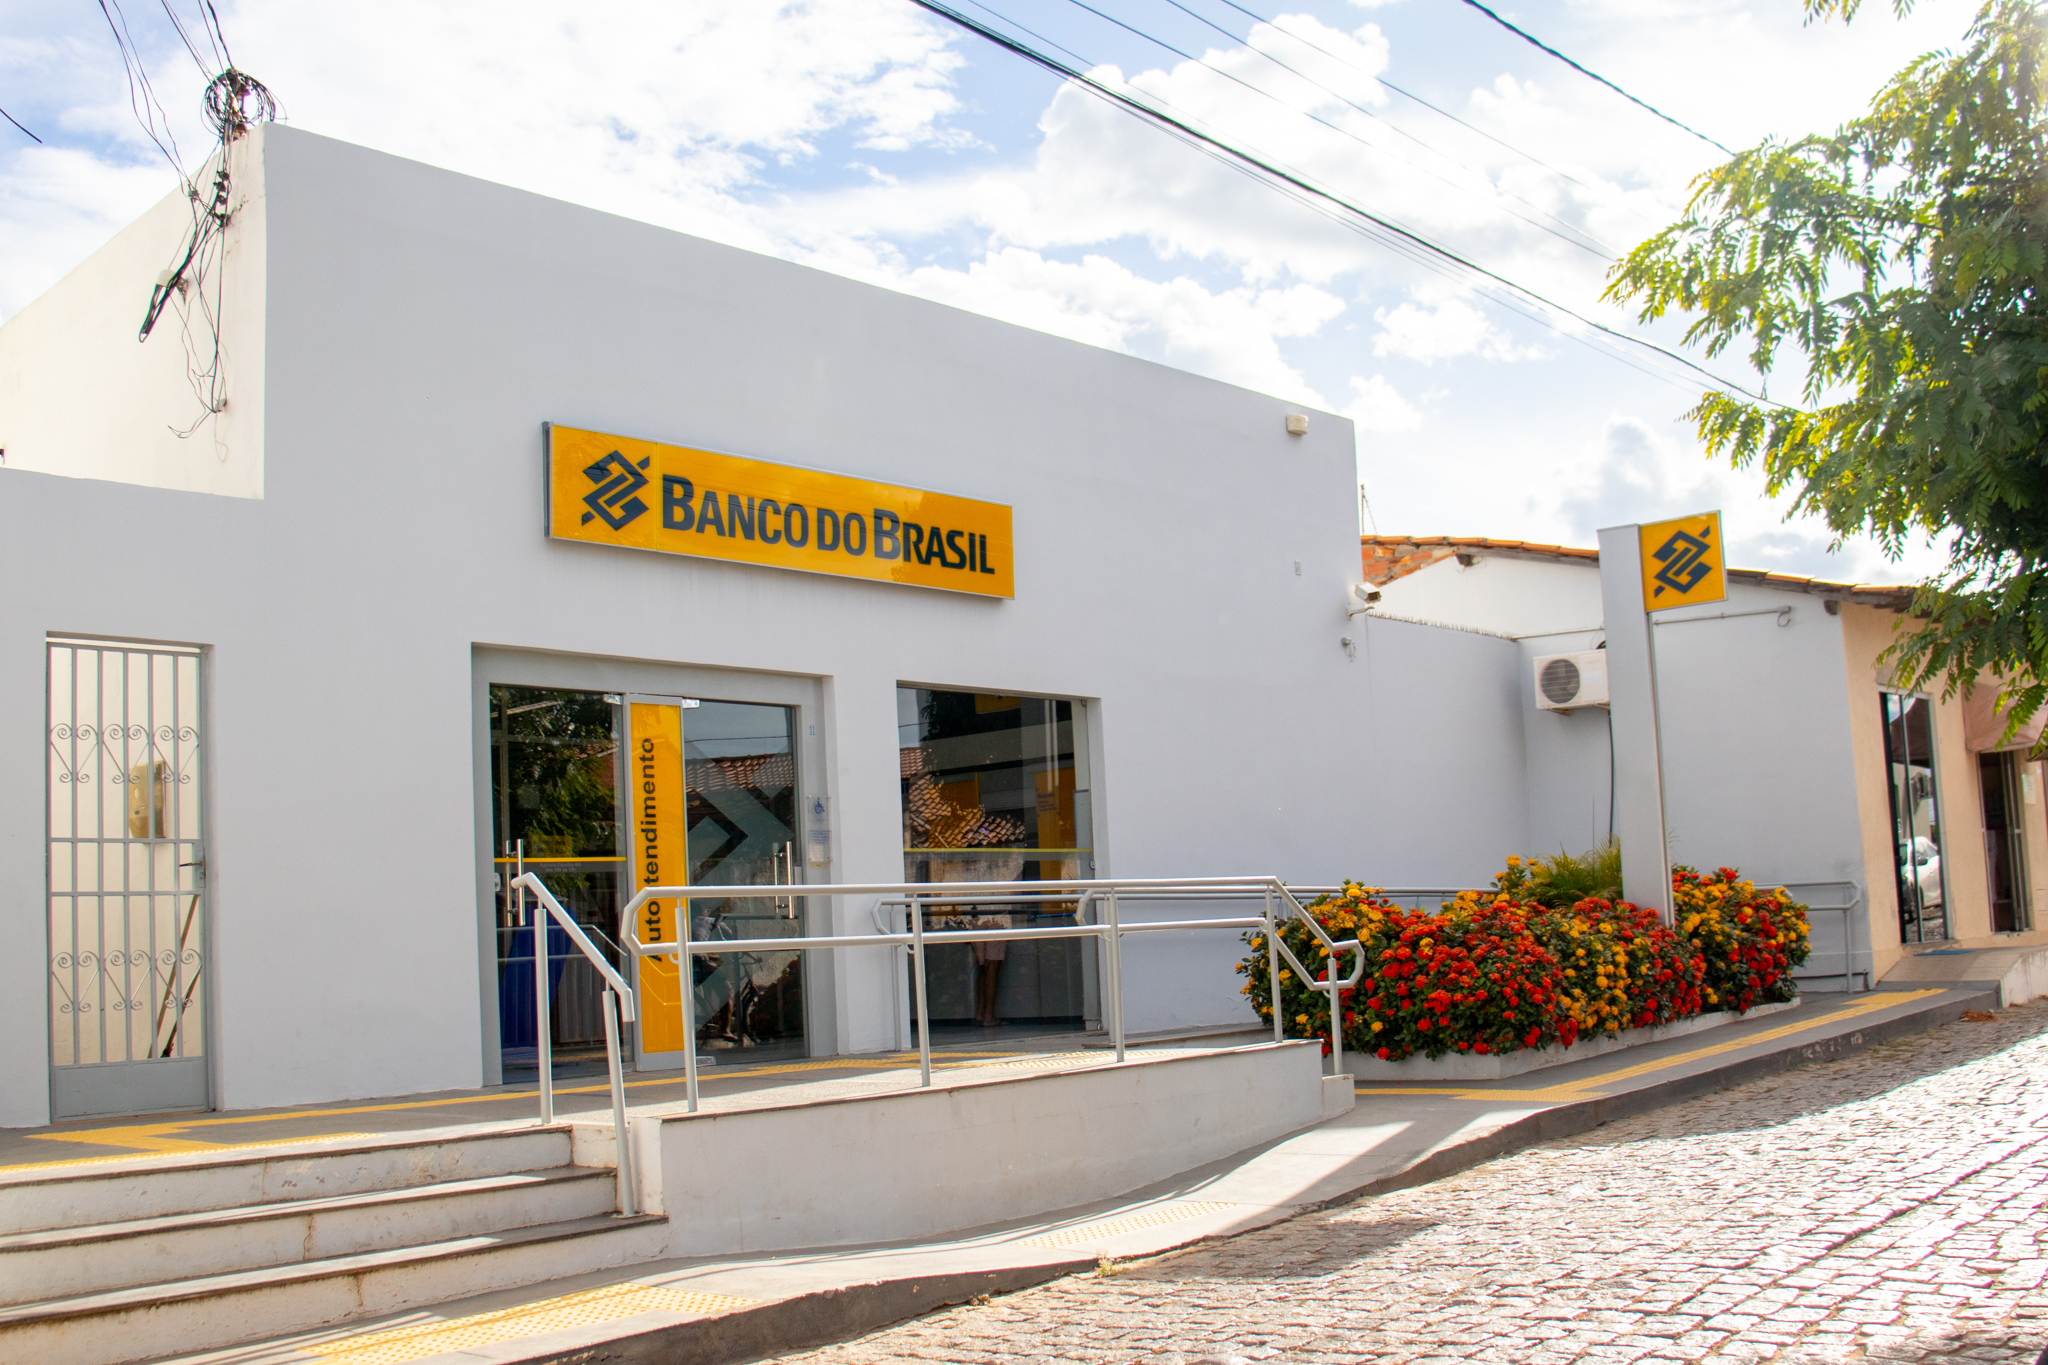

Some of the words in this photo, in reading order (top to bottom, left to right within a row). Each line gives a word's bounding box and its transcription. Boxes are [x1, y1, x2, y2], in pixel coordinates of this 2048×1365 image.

[662, 473, 809, 549] BANCO
[816, 507, 867, 557] DO
[873, 507, 995, 575] BRASIL
[639, 738, 663, 963] utotendimento
